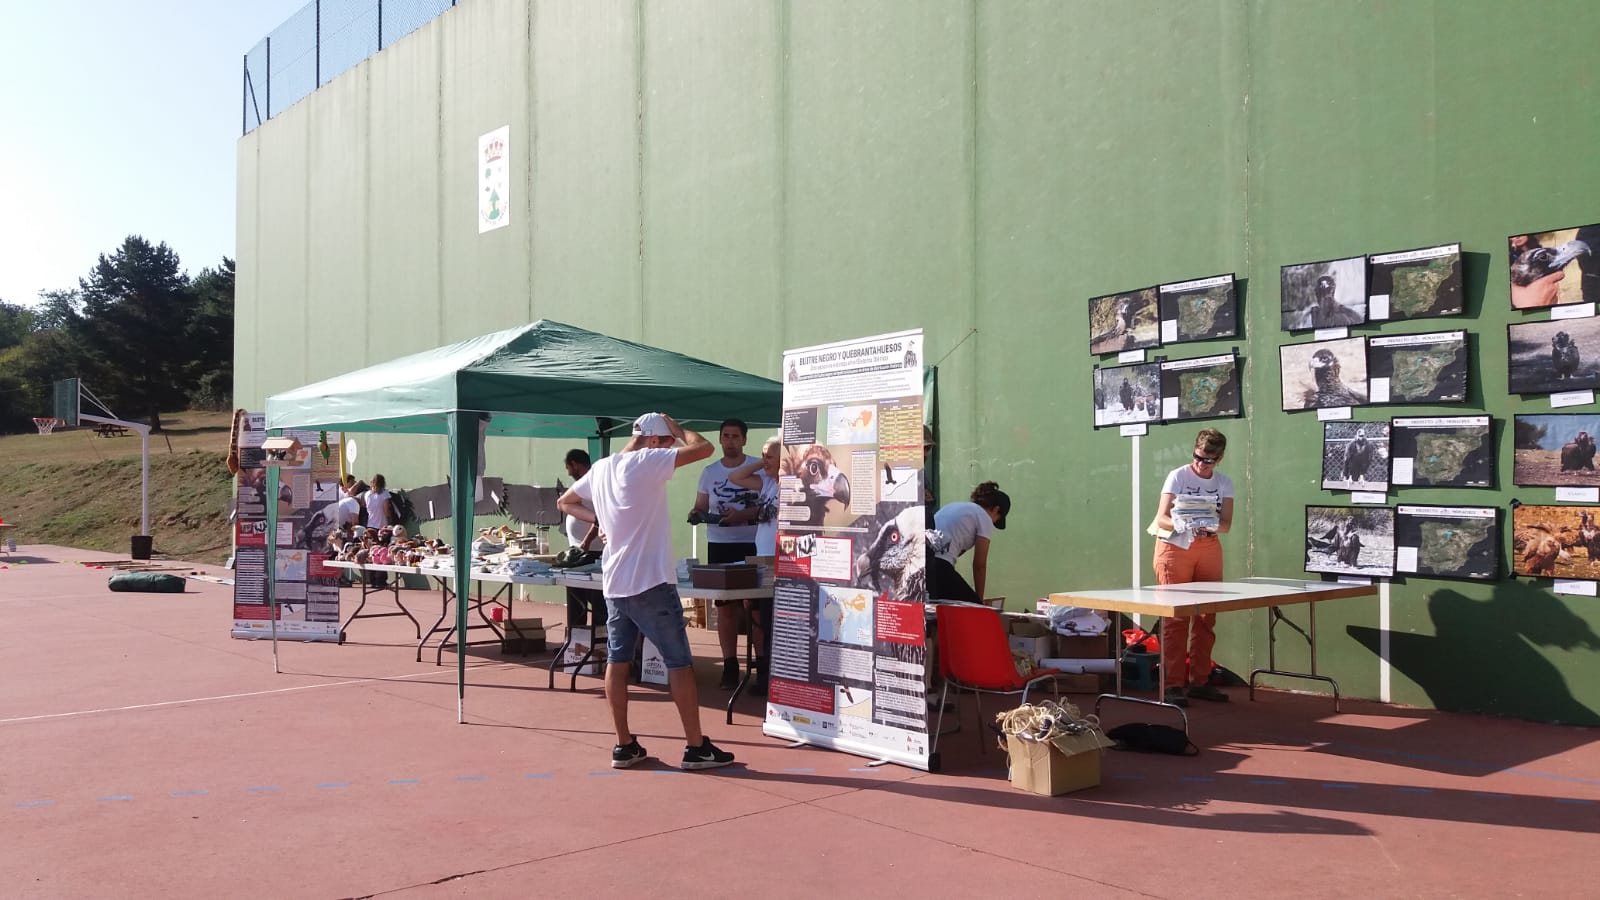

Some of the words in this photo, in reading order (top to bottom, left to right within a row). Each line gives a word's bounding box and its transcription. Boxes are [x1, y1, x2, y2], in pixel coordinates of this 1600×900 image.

[799, 355, 818, 366] BUITRE
[819, 351, 837, 363] NEGRO
[838, 351, 843, 360] Y
[842, 342, 902, 360] QUEBRANTAHUESOS
